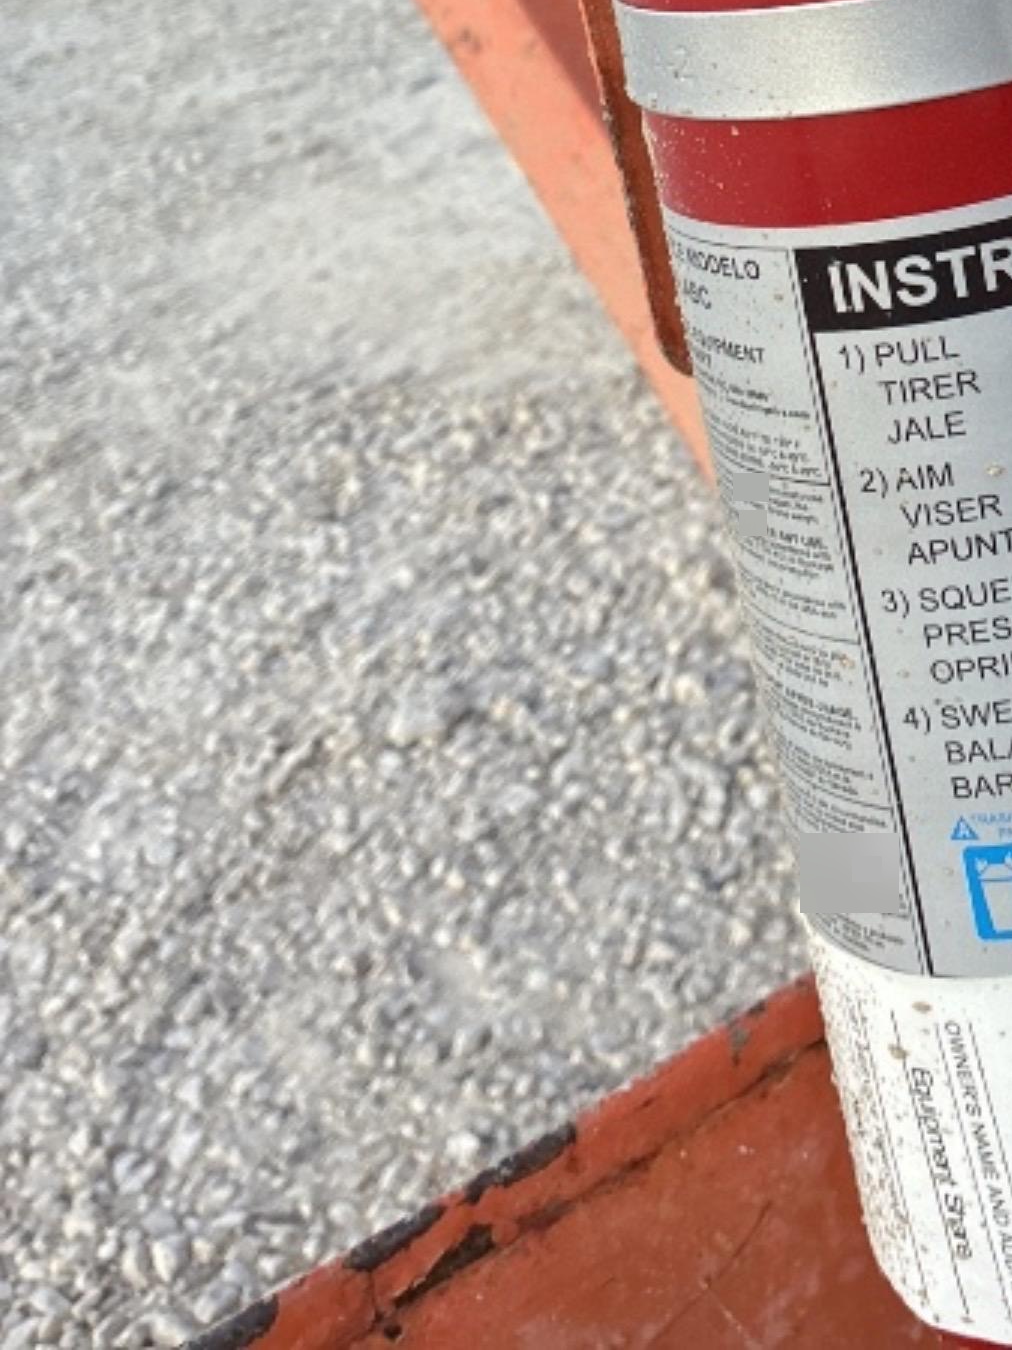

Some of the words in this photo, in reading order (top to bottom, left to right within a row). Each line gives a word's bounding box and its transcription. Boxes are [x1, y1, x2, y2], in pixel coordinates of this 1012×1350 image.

[874, 334, 961, 369] PULL
[878, 369, 982, 407] TIRER
[887, 410, 967, 445] JALE
[896, 462, 955, 493] AIM
[900, 493, 1003, 529] VISER
[945, 1019, 982, 1119] OWNER'S
[971, 1123, 997, 1180] NAME
[986, 1182, 1010, 1228] AND
[909, 1064, 956, 1189] Equipment
[942, 1190, 974, 1261] Share
